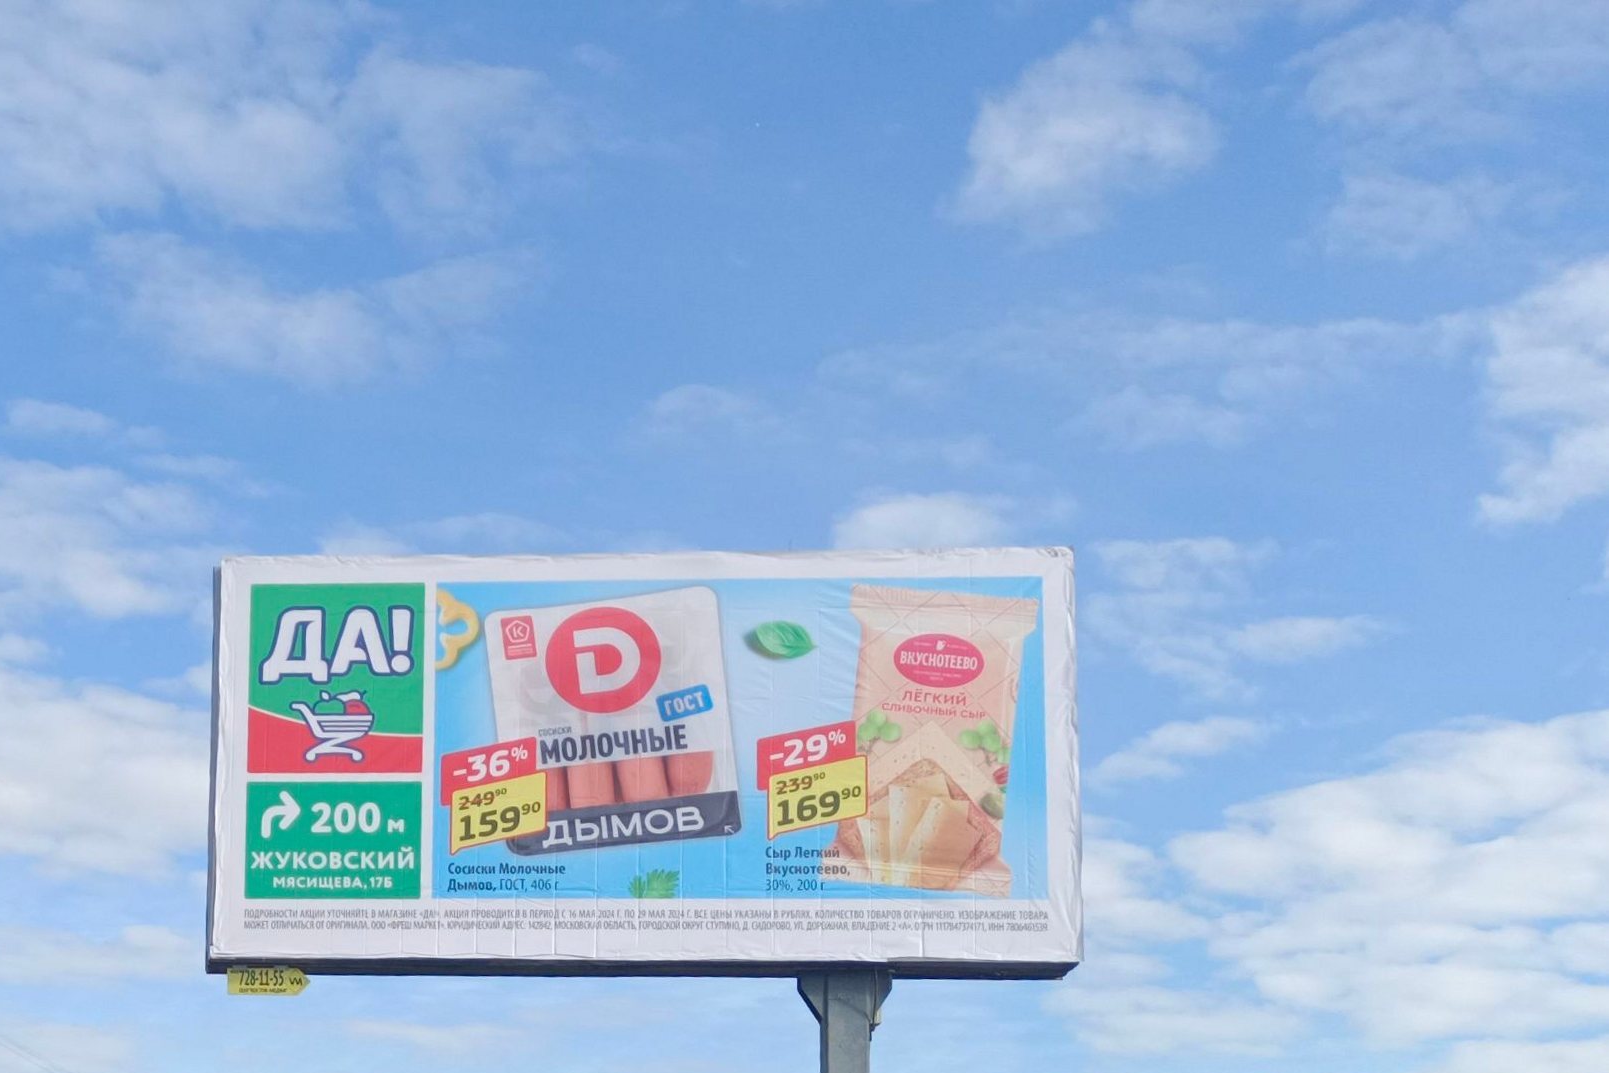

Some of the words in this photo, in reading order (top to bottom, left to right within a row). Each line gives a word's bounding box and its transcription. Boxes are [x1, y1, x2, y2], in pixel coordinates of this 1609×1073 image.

[260, 604, 415, 685] ДА!
[899, 650, 978, 670] ВКУСНОТЕЕВО
[663, 689, 705, 715] ГОСТ
[902, 688, 967, 706] ЛЁГКИЙ
[881, 702, 958, 717] СЛИВОЧНЫЙ
[960, 709, 986, 720] СЫР
[538, 726, 572, 737] СОСИСКИ
[540, 724, 688, 765] МОЛОЧНЫЕ
[310, 802, 381, 833] 200
[542, 806, 705, 849] ДЫМОВ
[250, 846, 415, 870] ЖУКОВСКИЙ
[765, 846, 792, 861] Сыр
[794, 846, 840, 859] Легкий
[448, 862, 495, 875] Сосиски
[499, 862, 566, 875] Молочные
[765, 863, 850, 877] Вкуснотеево,
[272, 876, 368, 889] МЯСИЩЕВА,
[369, 877, 393, 888] 17Б
[447, 879, 496, 892] Дымов,
[499, 879, 528, 892] ГОСТ,
[531, 879, 551, 891] 406
[765, 880, 793, 892] 30%,
[797, 880, 817, 891] 200
[239, 970, 284, 986] 728-11-55
